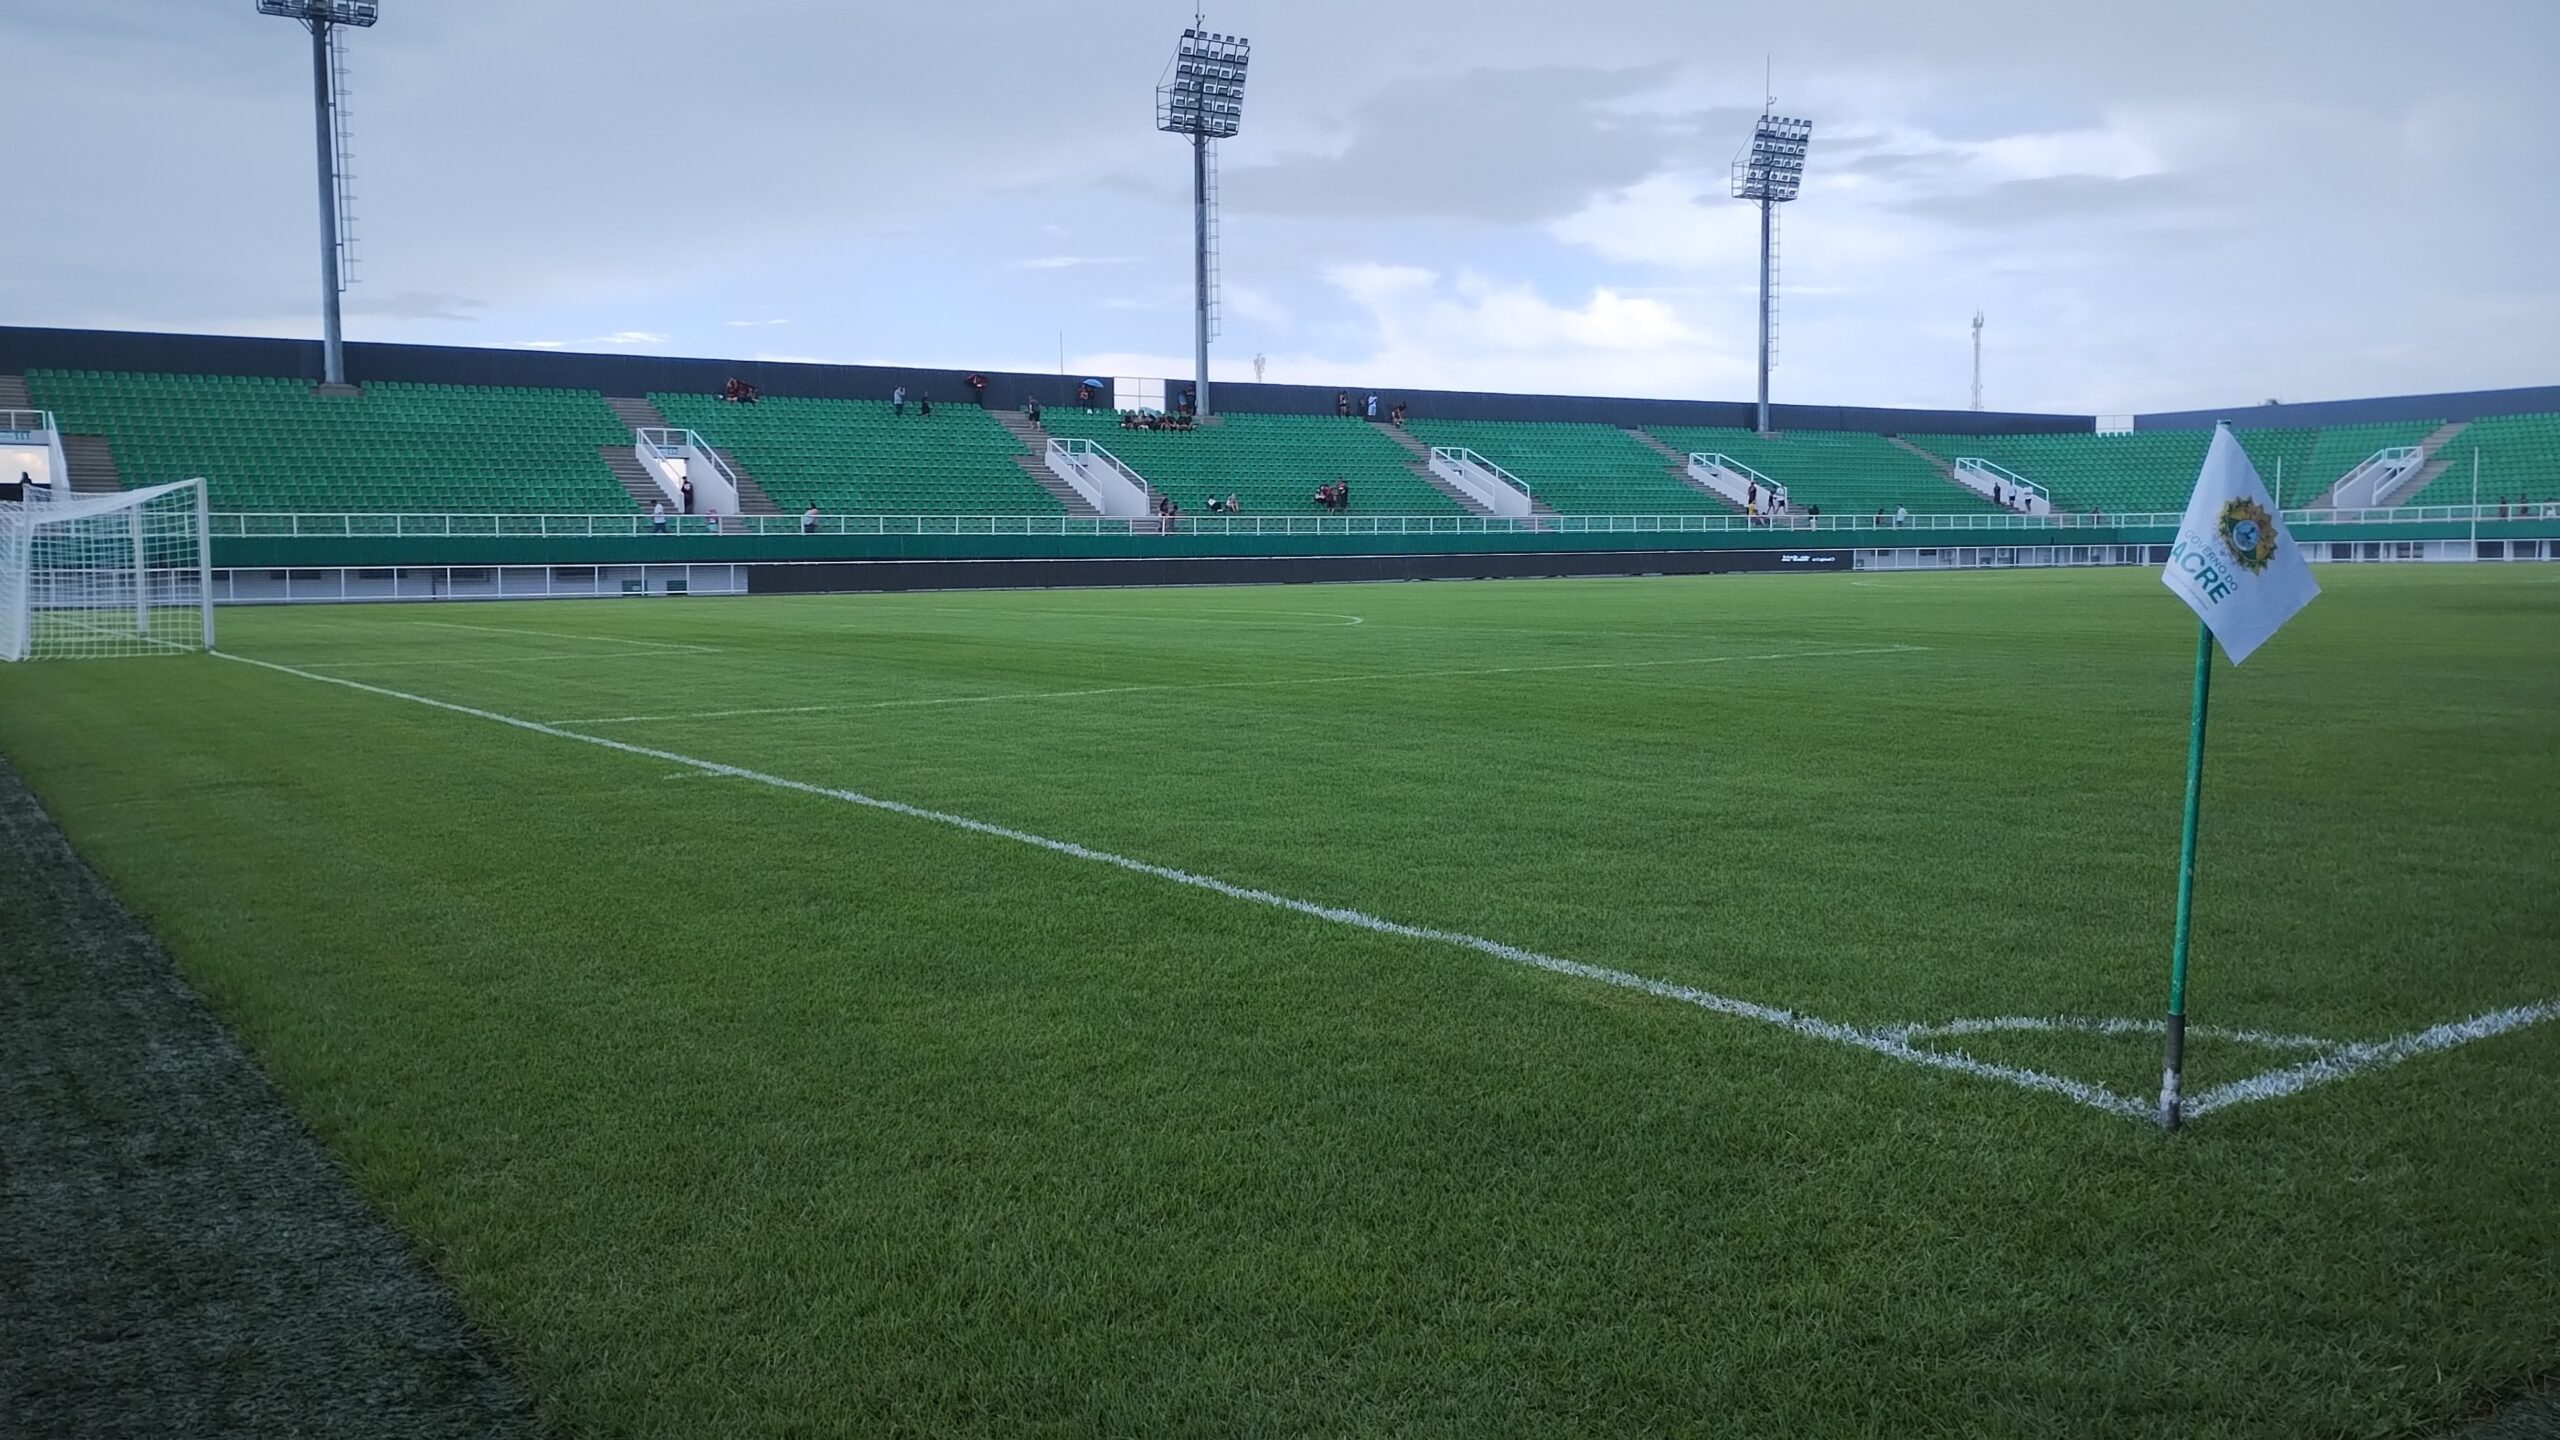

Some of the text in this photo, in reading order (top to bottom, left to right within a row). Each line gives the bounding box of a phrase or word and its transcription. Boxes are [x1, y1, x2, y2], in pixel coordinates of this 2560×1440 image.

[2172, 541, 2231, 605] ACRE
[2184, 529, 2227, 574] GOVERNO
[2224, 574, 2238, 591] DO
